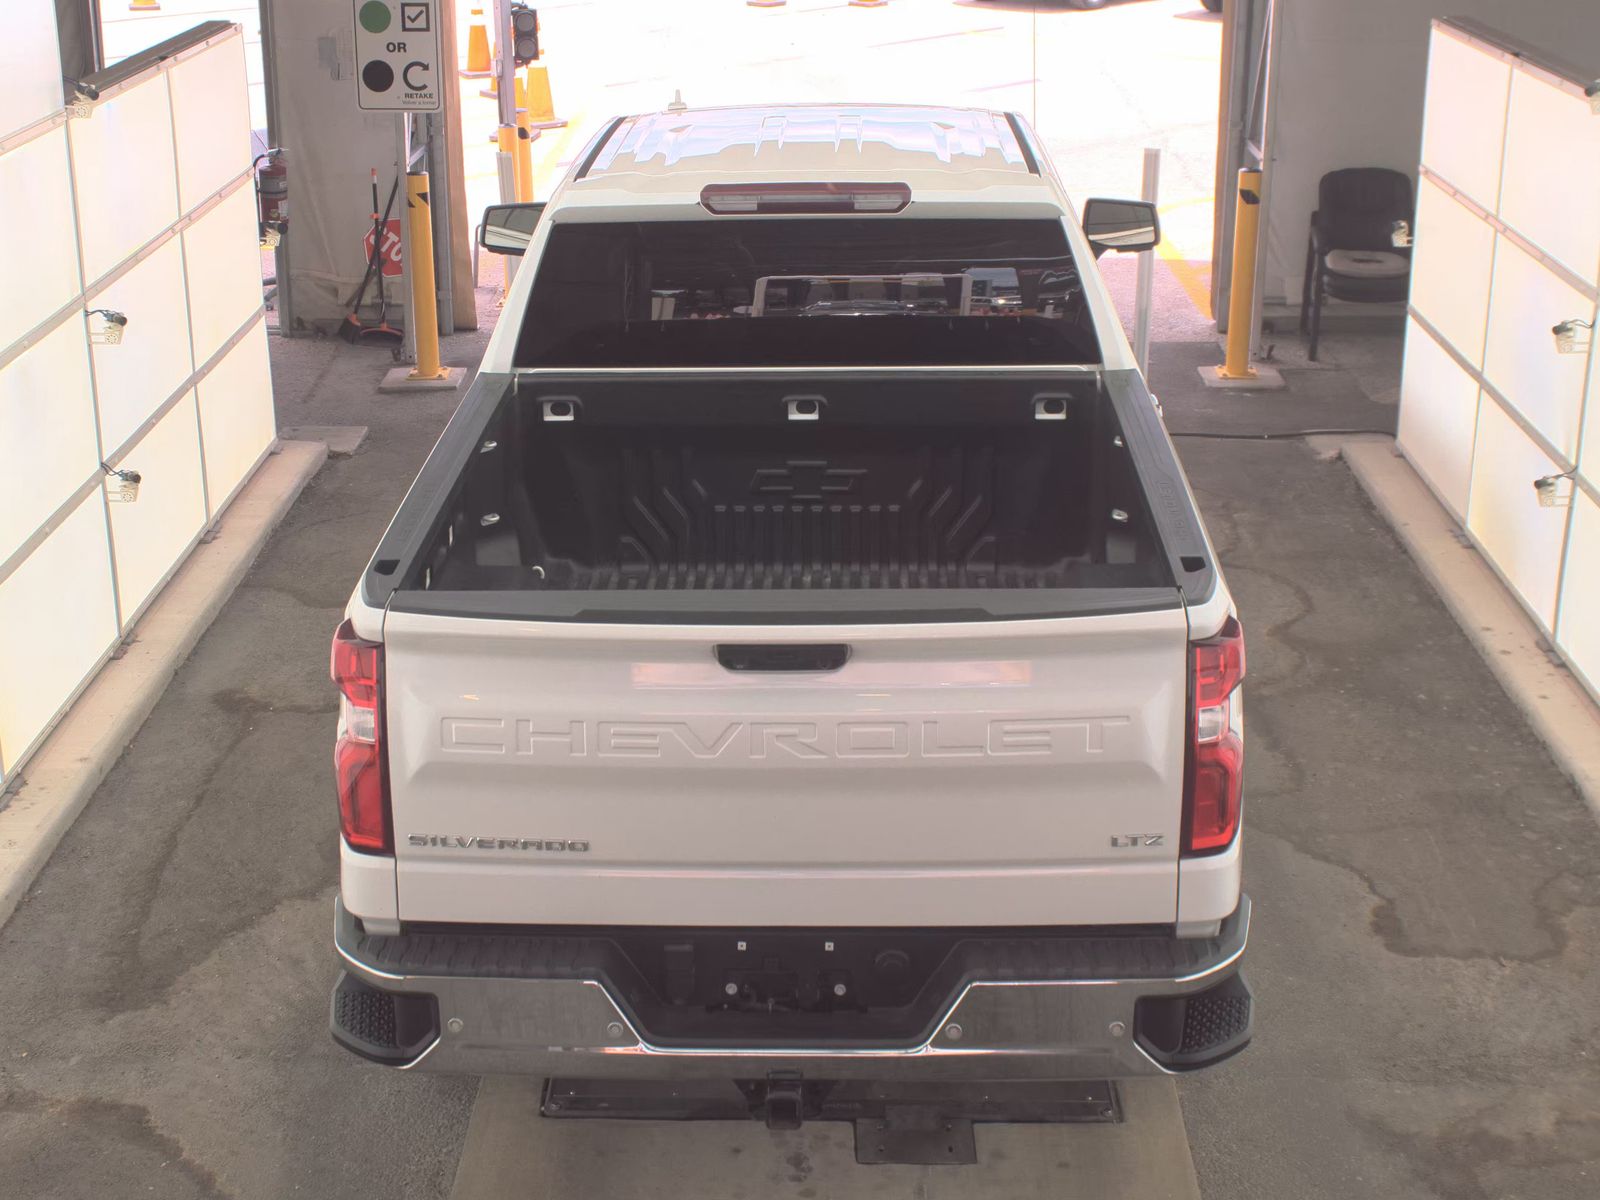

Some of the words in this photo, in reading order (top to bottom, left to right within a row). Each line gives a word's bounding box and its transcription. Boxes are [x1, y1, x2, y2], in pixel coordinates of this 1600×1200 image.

[386, 42, 407, 53] OR
[441, 715, 1131, 759] CHEVROLET
[407, 833, 590, 853] SILVERADO
[1110, 832, 1164, 848] LTZ
